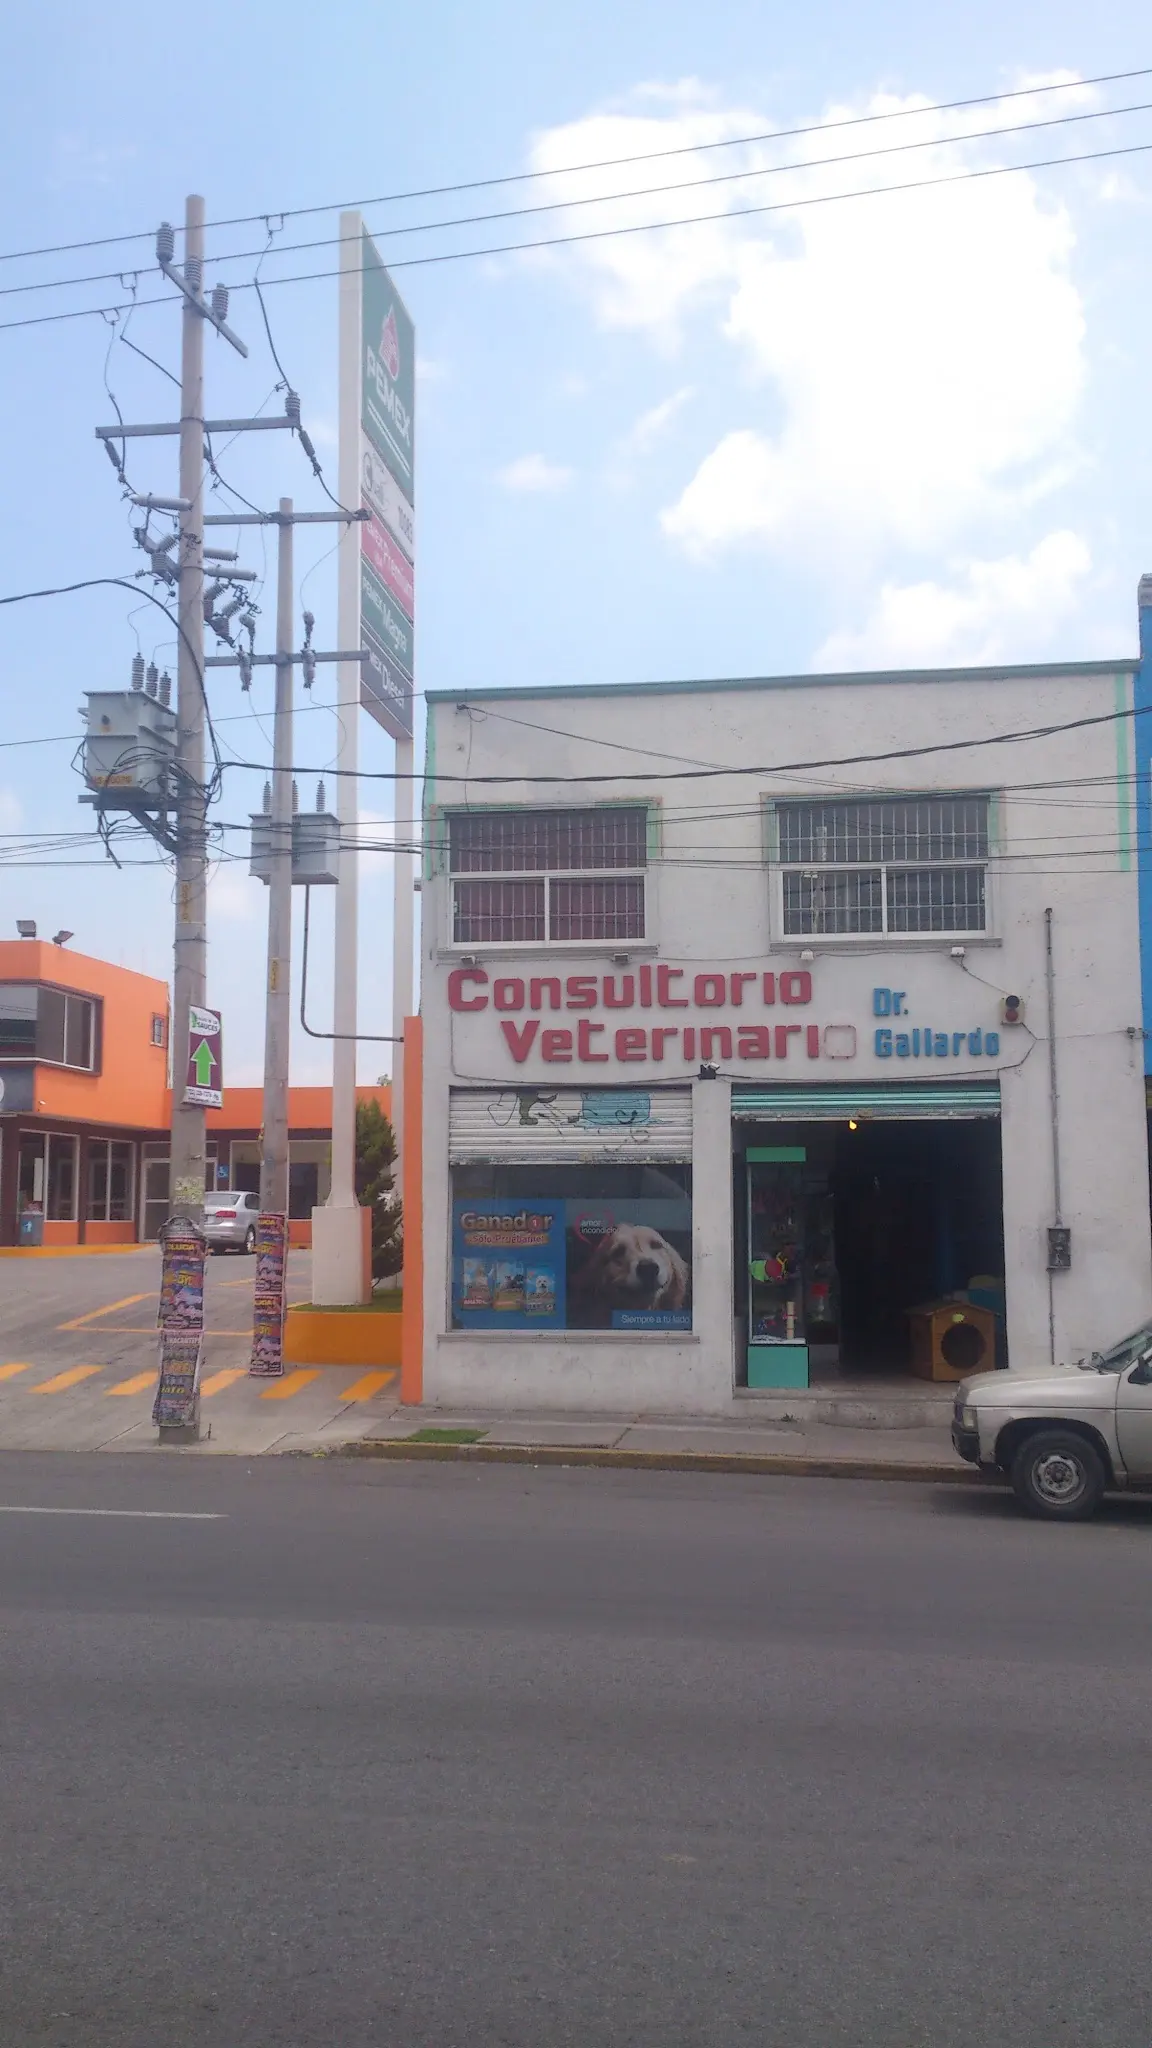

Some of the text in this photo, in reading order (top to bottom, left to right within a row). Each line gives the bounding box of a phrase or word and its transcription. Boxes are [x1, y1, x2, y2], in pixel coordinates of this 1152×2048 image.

[366, 344, 410, 448] PEMEX
[382, 602, 407, 655] Magna
[382, 664, 405, 711] Diesel
[448, 965, 812, 1012] Consultorio
[873, 988, 908, 1016] Dr.
[875, 1027, 999, 1057] Gallardo
[621, 1314, 655, 1324] Siempre
[673, 1315, 690, 1323] lado
